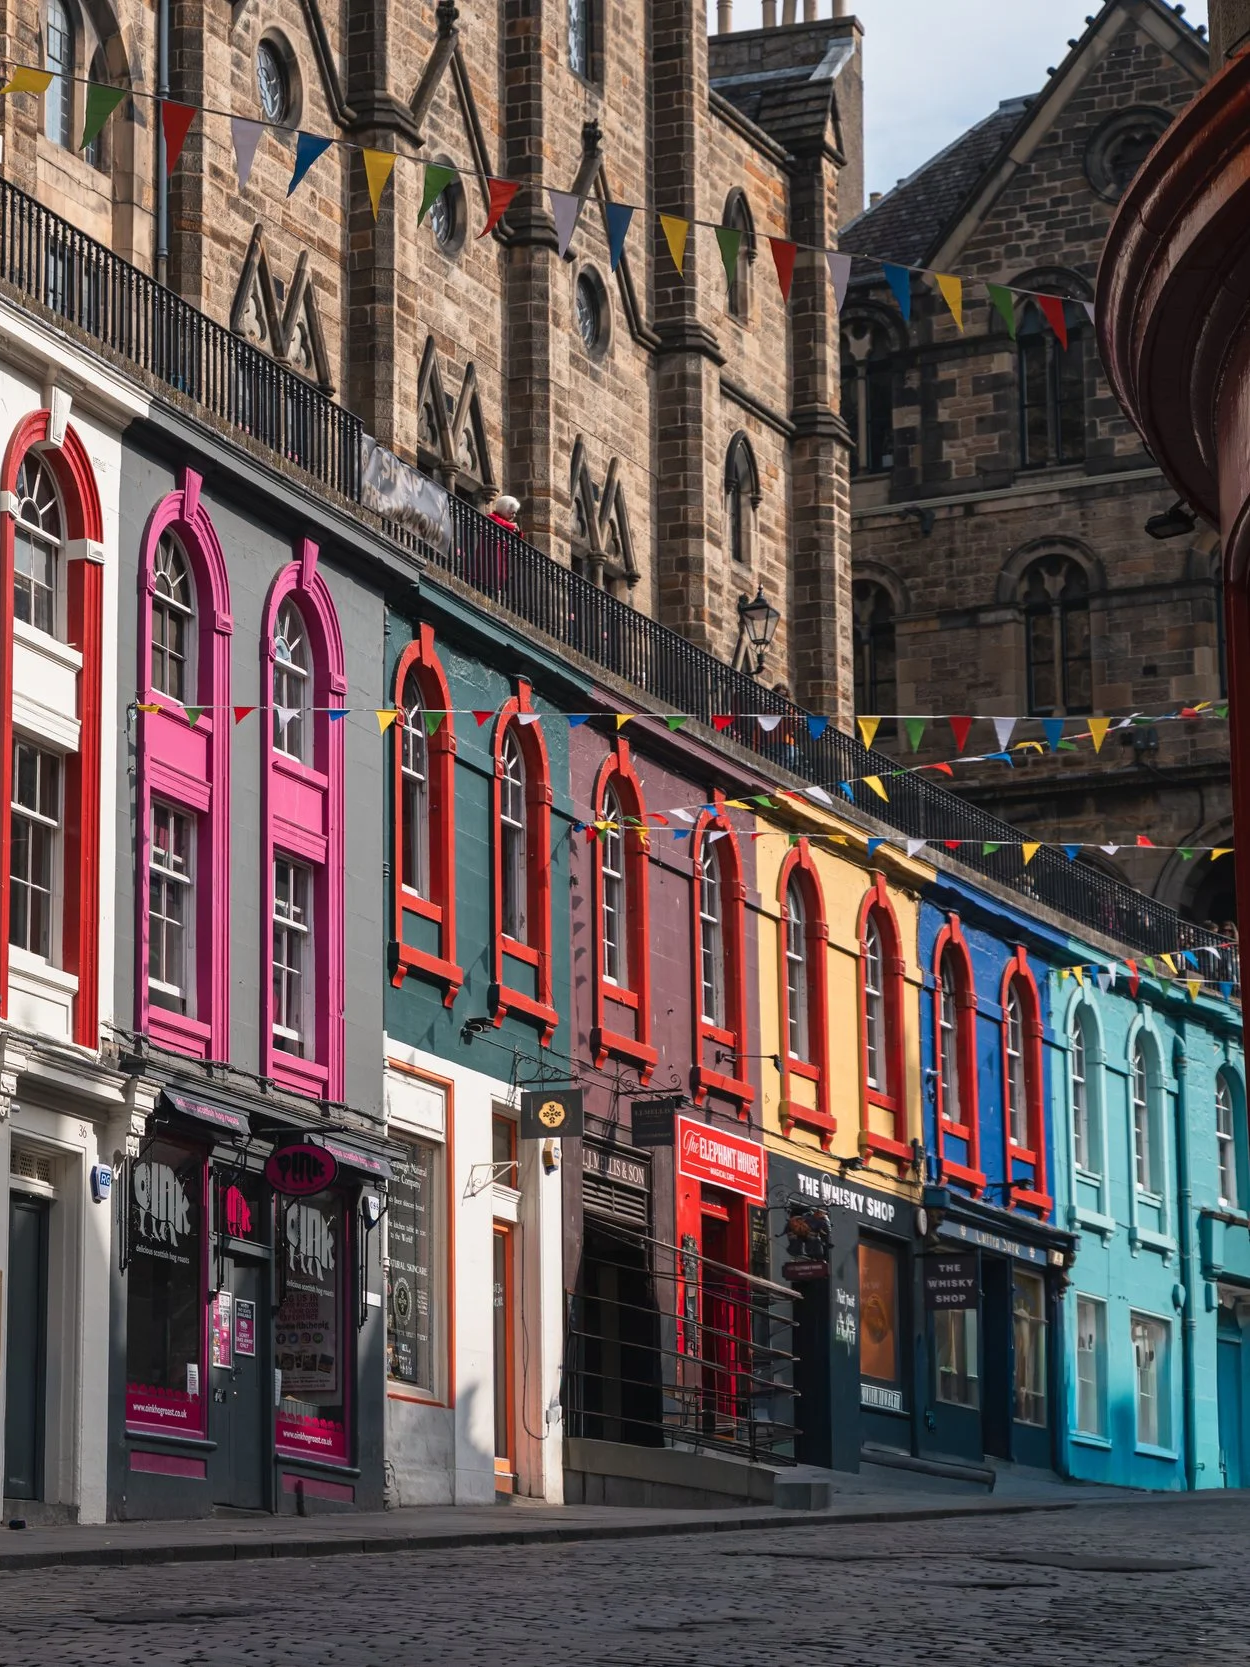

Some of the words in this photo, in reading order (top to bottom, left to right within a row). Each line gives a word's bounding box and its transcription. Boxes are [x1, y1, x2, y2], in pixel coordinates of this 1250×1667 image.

[215, 1110, 225, 1123] hog
[225, 1115, 240, 1126] roasts
[79, 1125, 88, 1139] 36
[683, 1129, 701, 1156] The
[700, 1137, 737, 1170] ELEPHANT
[737, 1149, 760, 1178] HOUSE
[621, 1162, 627, 1179] &
[628, 1163, 645, 1185] SON
[797, 1173, 820, 1198] THE
[822, 1180, 865, 1214] WHISKY
[867, 1197, 895, 1223] SHOP
[153, 1248, 169, 1258] scottish
[169, 1251, 177, 1263] hog
[177, 1255, 190, 1265] roasts
[938, 1264, 961, 1272] THE
[927, 1278, 974, 1288] WHISKY
[936, 1295, 966, 1303] SHOP
[133, 1403, 187, 1419] www.oinkhogroast.co.uk
[282, 1429, 332, 1447] www.oinkhogroast.co.uk
